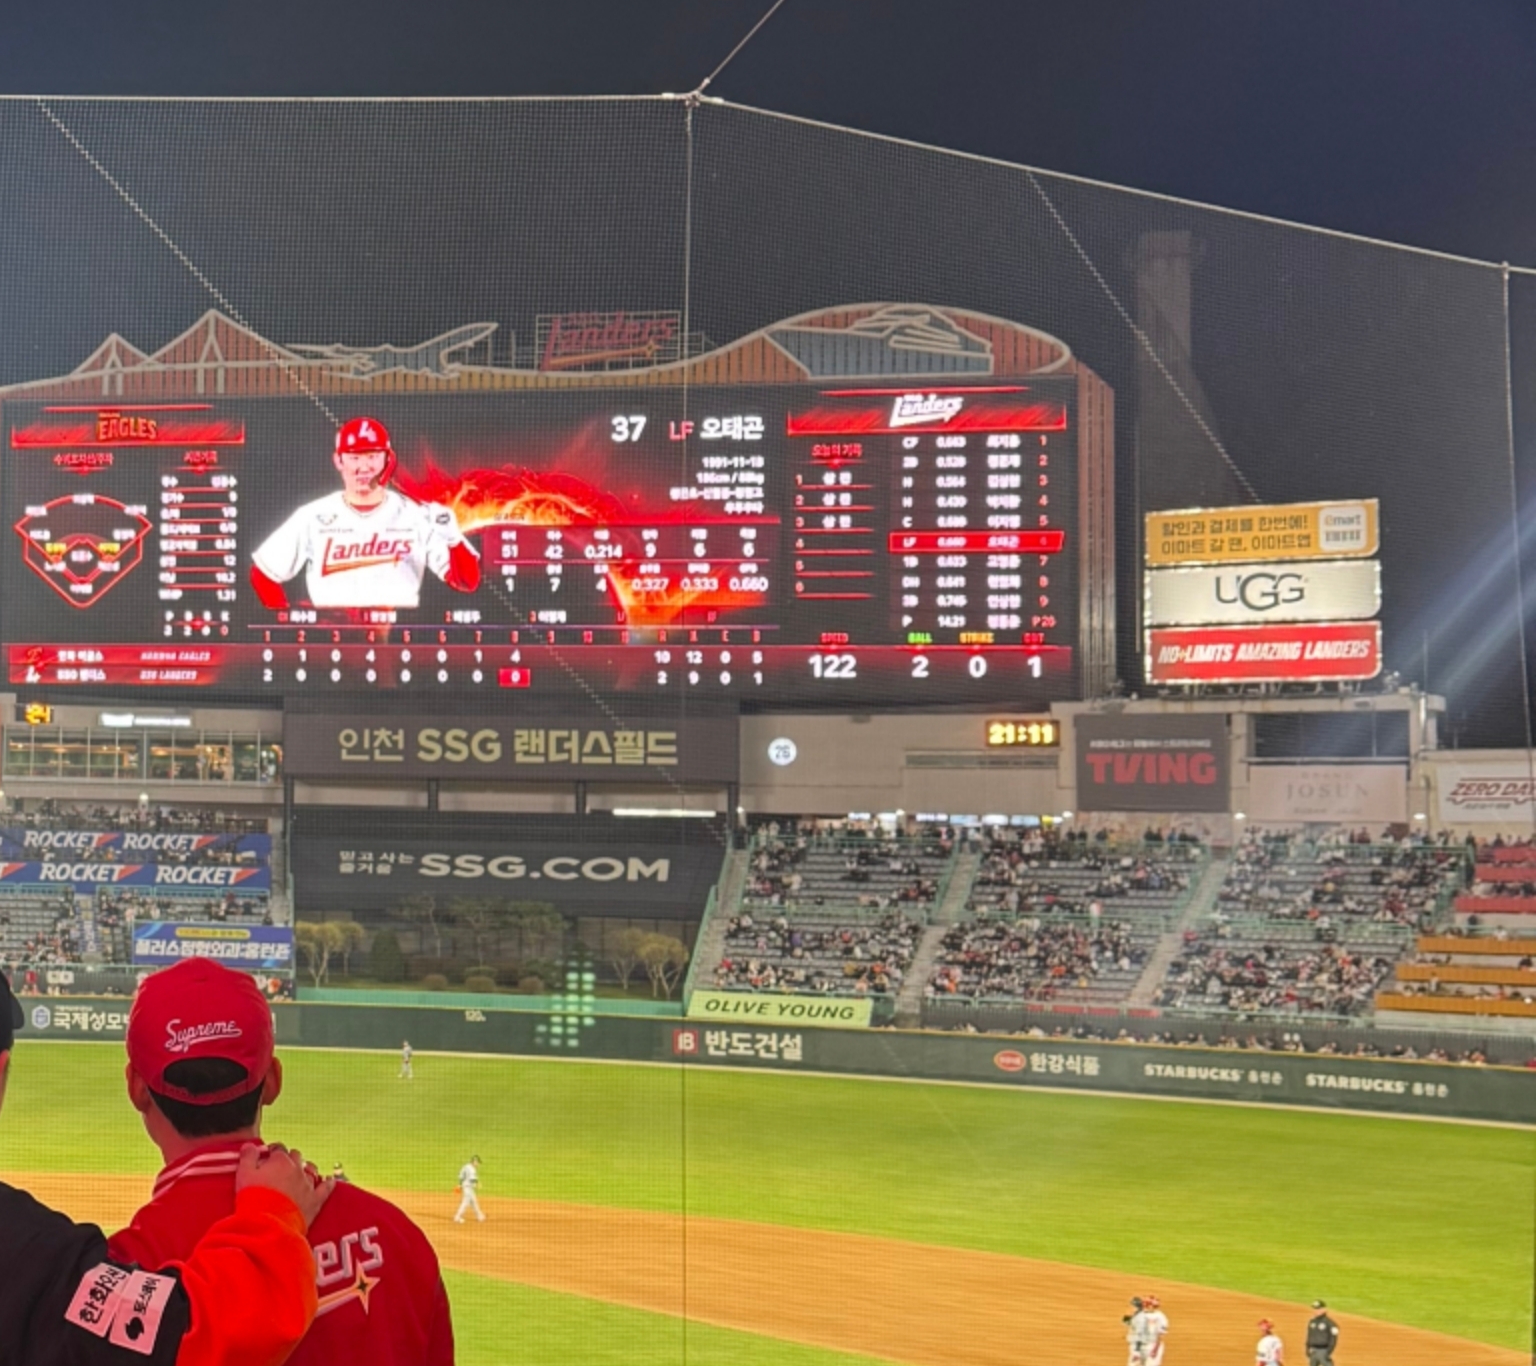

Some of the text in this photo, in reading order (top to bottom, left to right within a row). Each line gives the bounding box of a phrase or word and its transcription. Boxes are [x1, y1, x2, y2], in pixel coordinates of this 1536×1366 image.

[98, 416, 158, 441] EAGLES
[611, 415, 765, 442] 37 LF 오태곤
[1161, 514, 1309, 536] 할인과 결제를 한번에!
[321, 533, 414, 577] Landers
[501, 544, 754, 558] 51 42 0.214 9 6 6
[1161, 538, 1206, 556] 이마트
[506, 578, 514, 592] 1
[550, 578, 560, 592] 7
[596, 578, 607, 592] 4
[1214, 572, 1306, 611] UGG
[1236, 640, 1301, 661] AMAZING
[1303, 638, 1372, 660] LANDERS
[808, 655, 1042, 678] 122 2 0 1
[988, 722, 1054, 746] 21:11
[339, 728, 678, 766] 인천 SSG 랜더스필드
[1085, 752, 1218, 785] TVING
[1450, 782, 1500, 796] ZERO
[24, 829, 104, 850] ROCKET
[123, 832, 206, 851] ROCKET
[39, 862, 126, 882] ROCKET
[155, 865, 242, 885] ROCKET
[417, 852, 670, 882] SSG.COM
[53, 1011, 130, 1029] 국제성모
[704, 999, 855, 1020] OLIVE YOUNG
[165, 1019, 242, 1052] Supreme
[705, 1031, 802, 1061] 반도건설
[1029, 1053, 1100, 1076] 한강식품
[1144, 1063, 1242, 1082] STARBUCKS
[1305, 1073, 1406, 1094] STARBUCKS
[317, 1225, 384, 1286] ers
